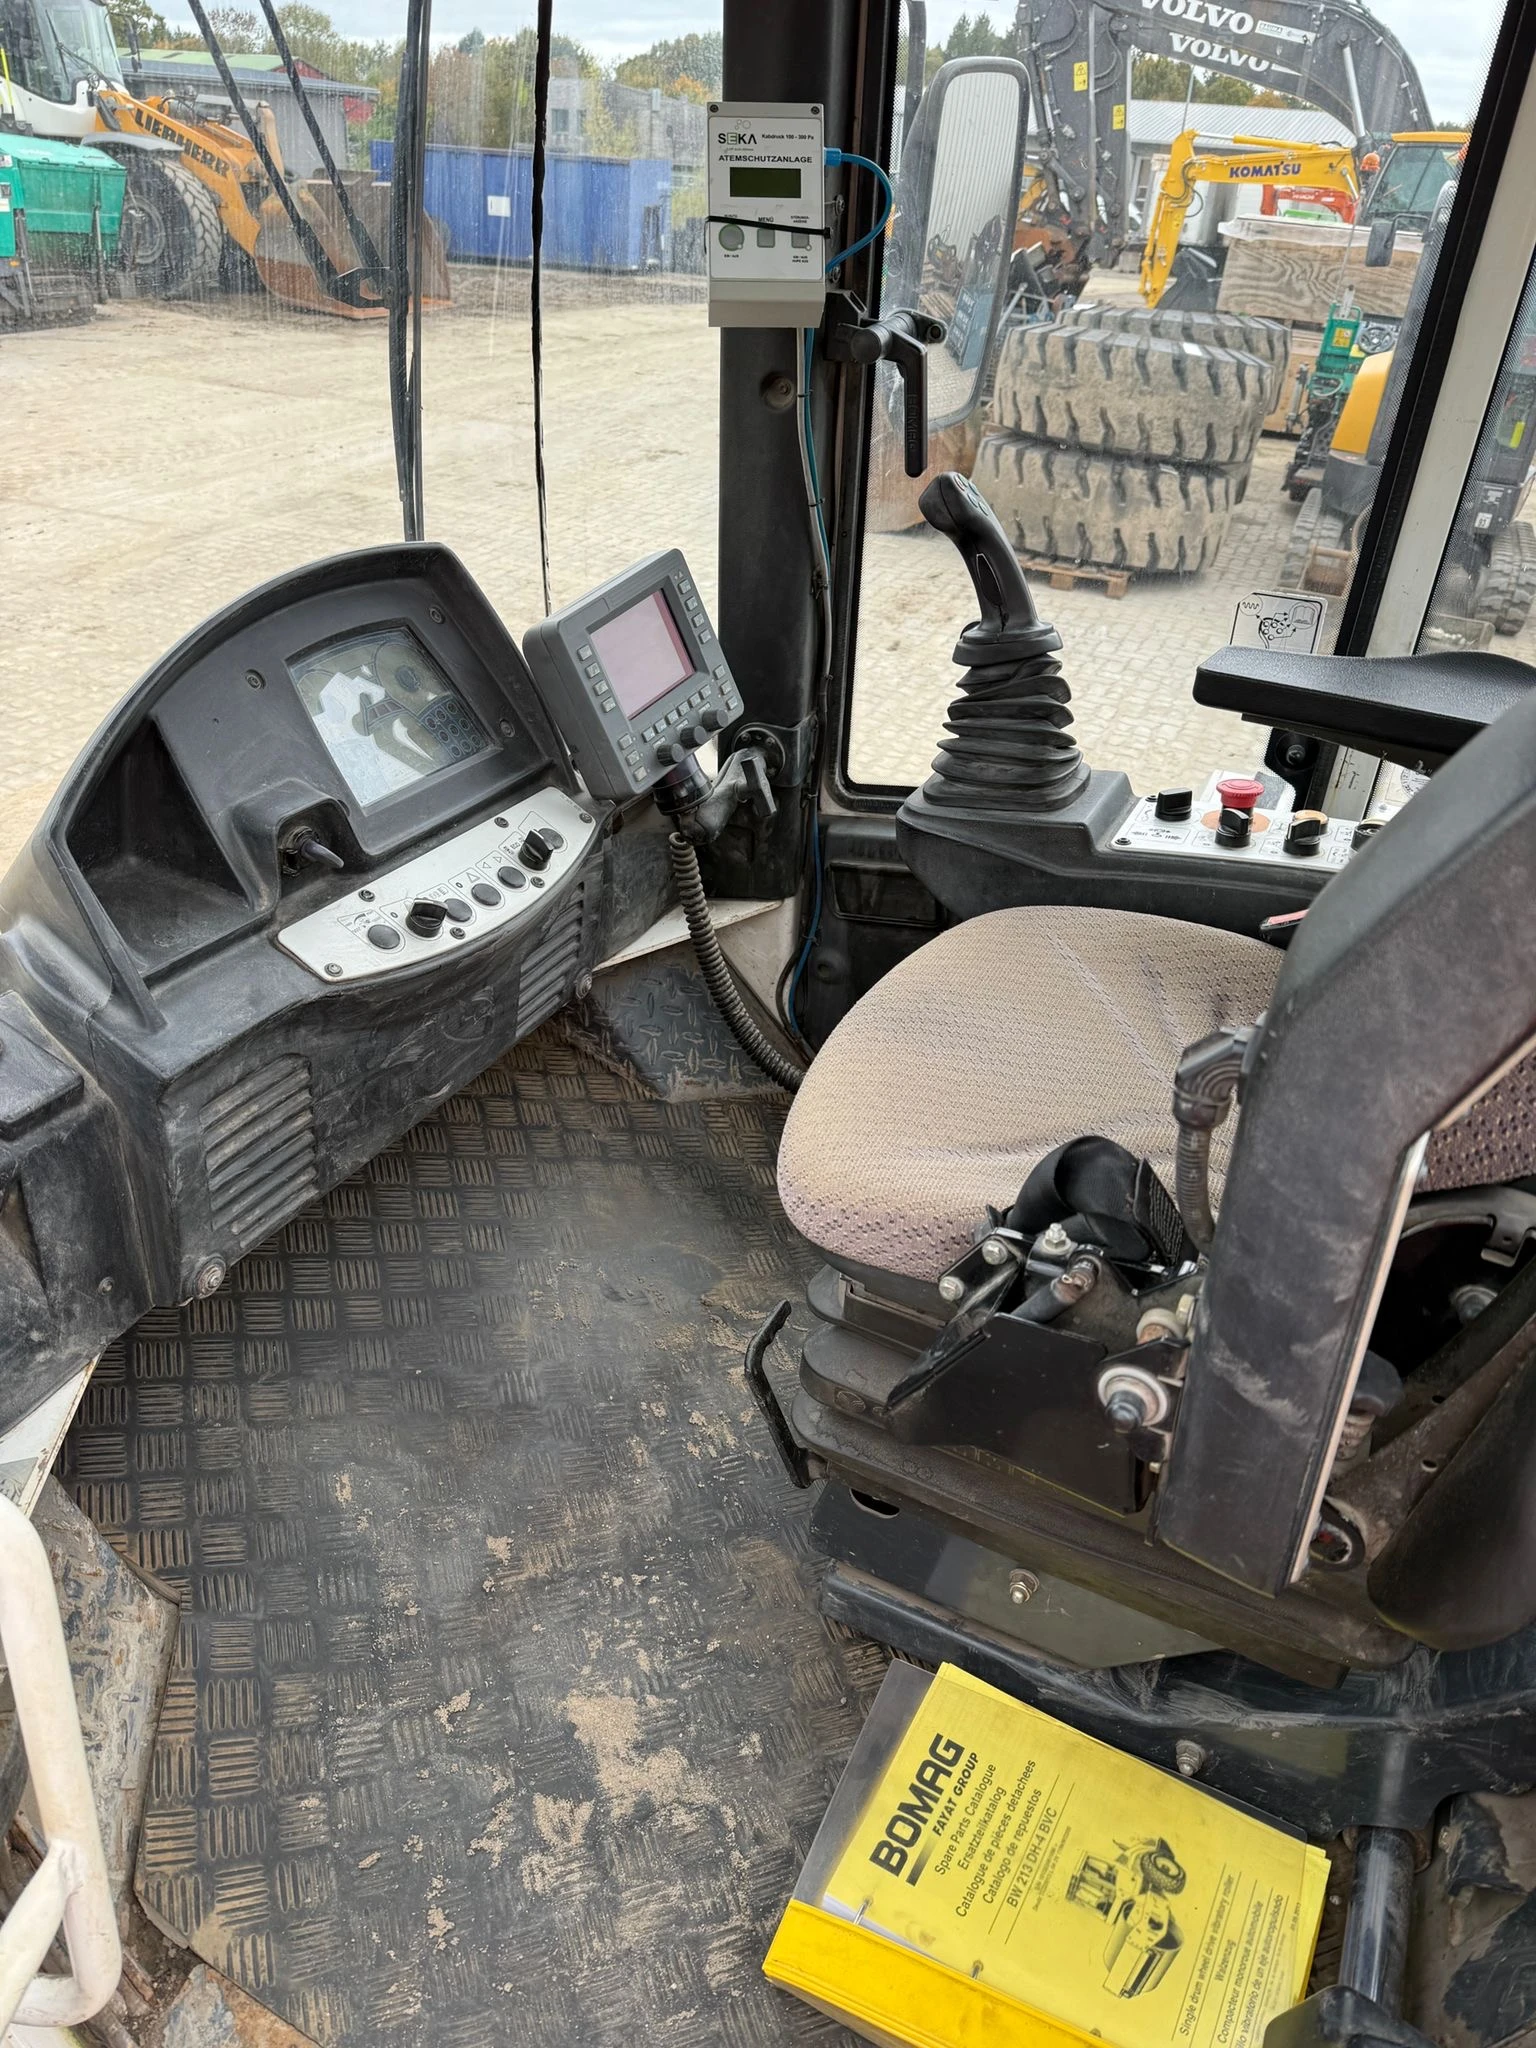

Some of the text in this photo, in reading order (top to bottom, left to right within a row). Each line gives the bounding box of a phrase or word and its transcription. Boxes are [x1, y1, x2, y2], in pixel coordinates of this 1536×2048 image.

[718, 133, 757, 145] SEKA
[718, 154, 813, 164] ATEMSCHUTZANLAGE
[1229, 161, 1302, 178] KOMATSU
[869, 1733, 966, 1878] BOMAG
[932, 1752, 979, 1837] FAYAT GROUP
[934, 1764, 997, 1876] Spare Parts Catalogue
[957, 1786, 1007, 1871] Ersatzteilkatalog
[955, 1863, 989, 1918] Catalogue
[983, 1848, 996, 1863] de
[1006, 1760, 1036, 1813] detachees
[982, 1789, 1042, 1905] Catalogo de repuestos
[1006, 1885, 1023, 1908] BW
[1016, 1864, 1033, 1887] 213
[1026, 1834, 1046, 1864] DH-4
[1038, 1807, 1057, 1835] BVC
[1179, 2005, 1197, 2037] Single
[1190, 1981, 1203, 2005] drum
[1198, 1955, 1210, 1981] wheel
[1217, 1988, 1240, 2044] Compacteur
[1241, 1991, 1259, 2034] vibratorio
[1252, 1979, 1262, 1991] de
